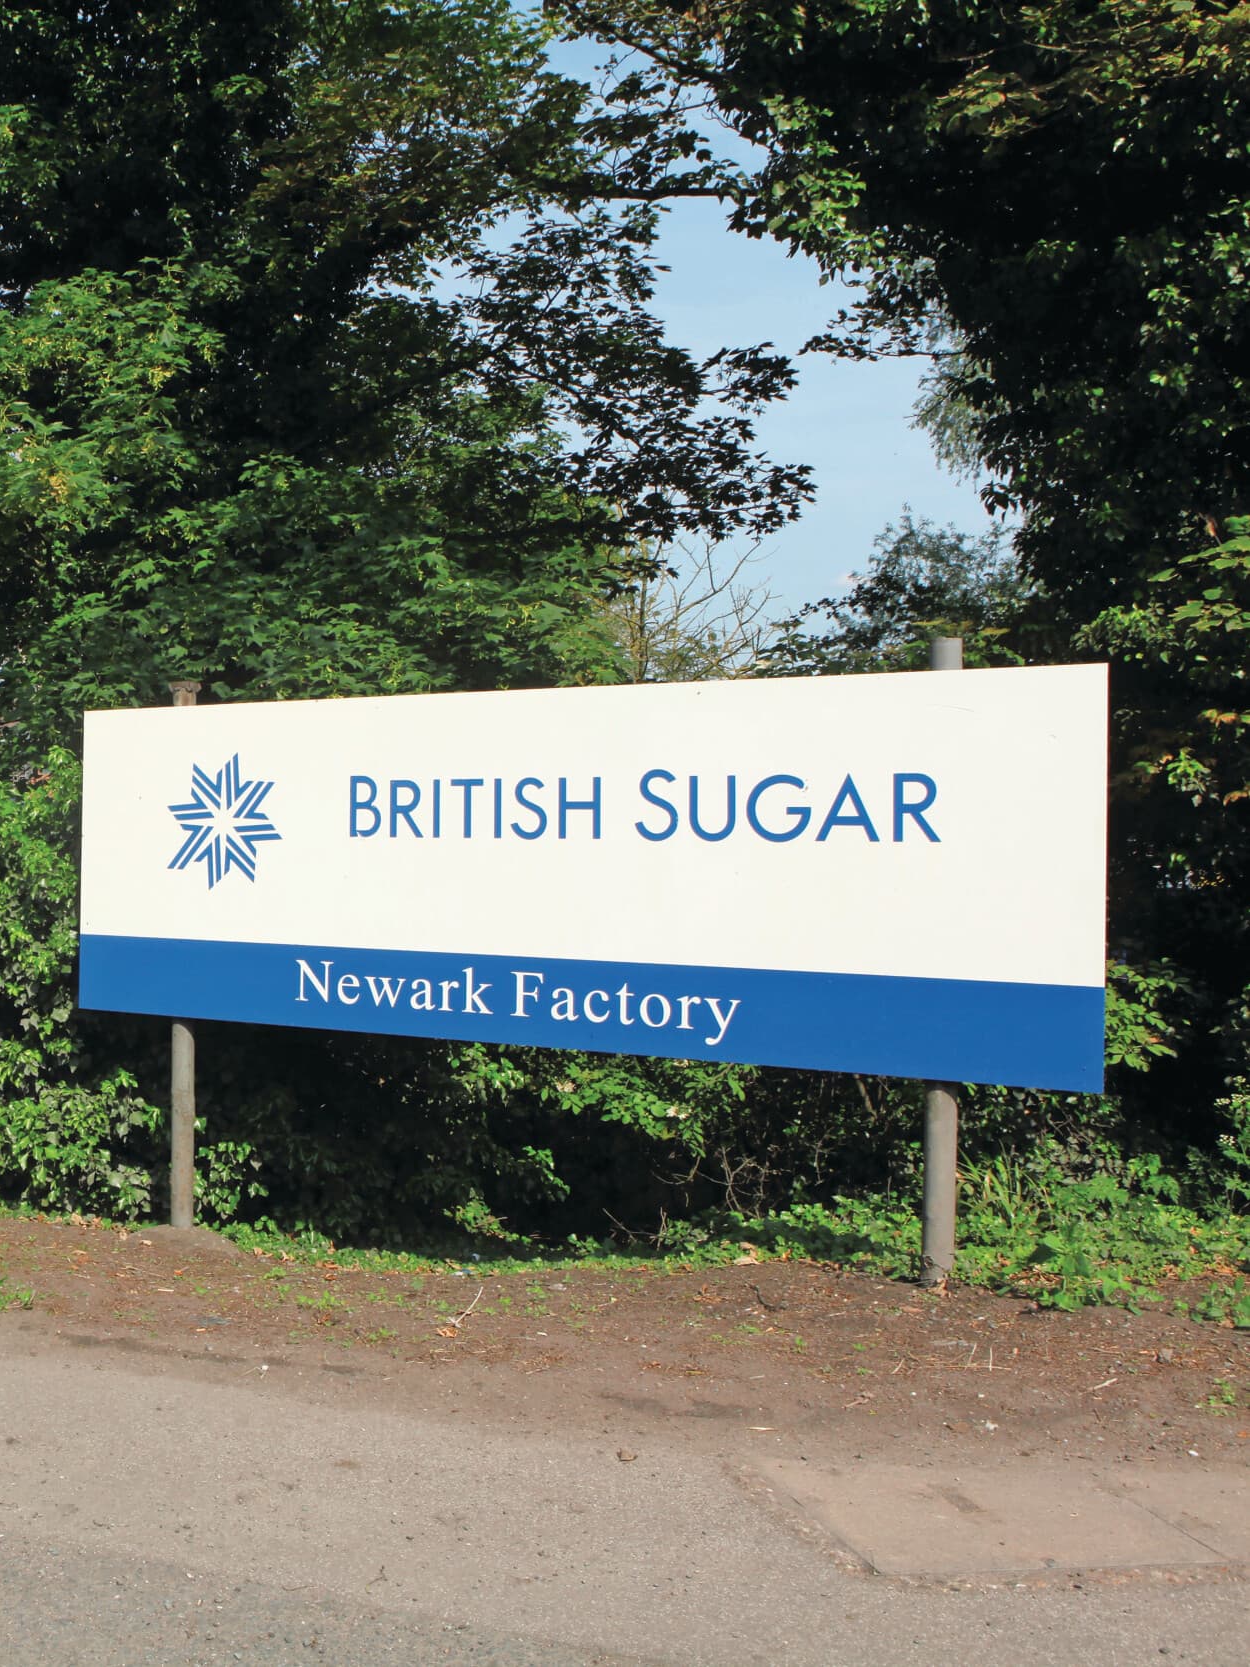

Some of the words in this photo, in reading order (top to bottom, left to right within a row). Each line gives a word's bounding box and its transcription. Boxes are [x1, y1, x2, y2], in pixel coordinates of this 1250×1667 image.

[349, 775, 602, 841] BRITISH
[634, 768, 942, 844] SUGAR
[294, 959, 494, 1015] Newark
[509, 971, 741, 1047] Factory
